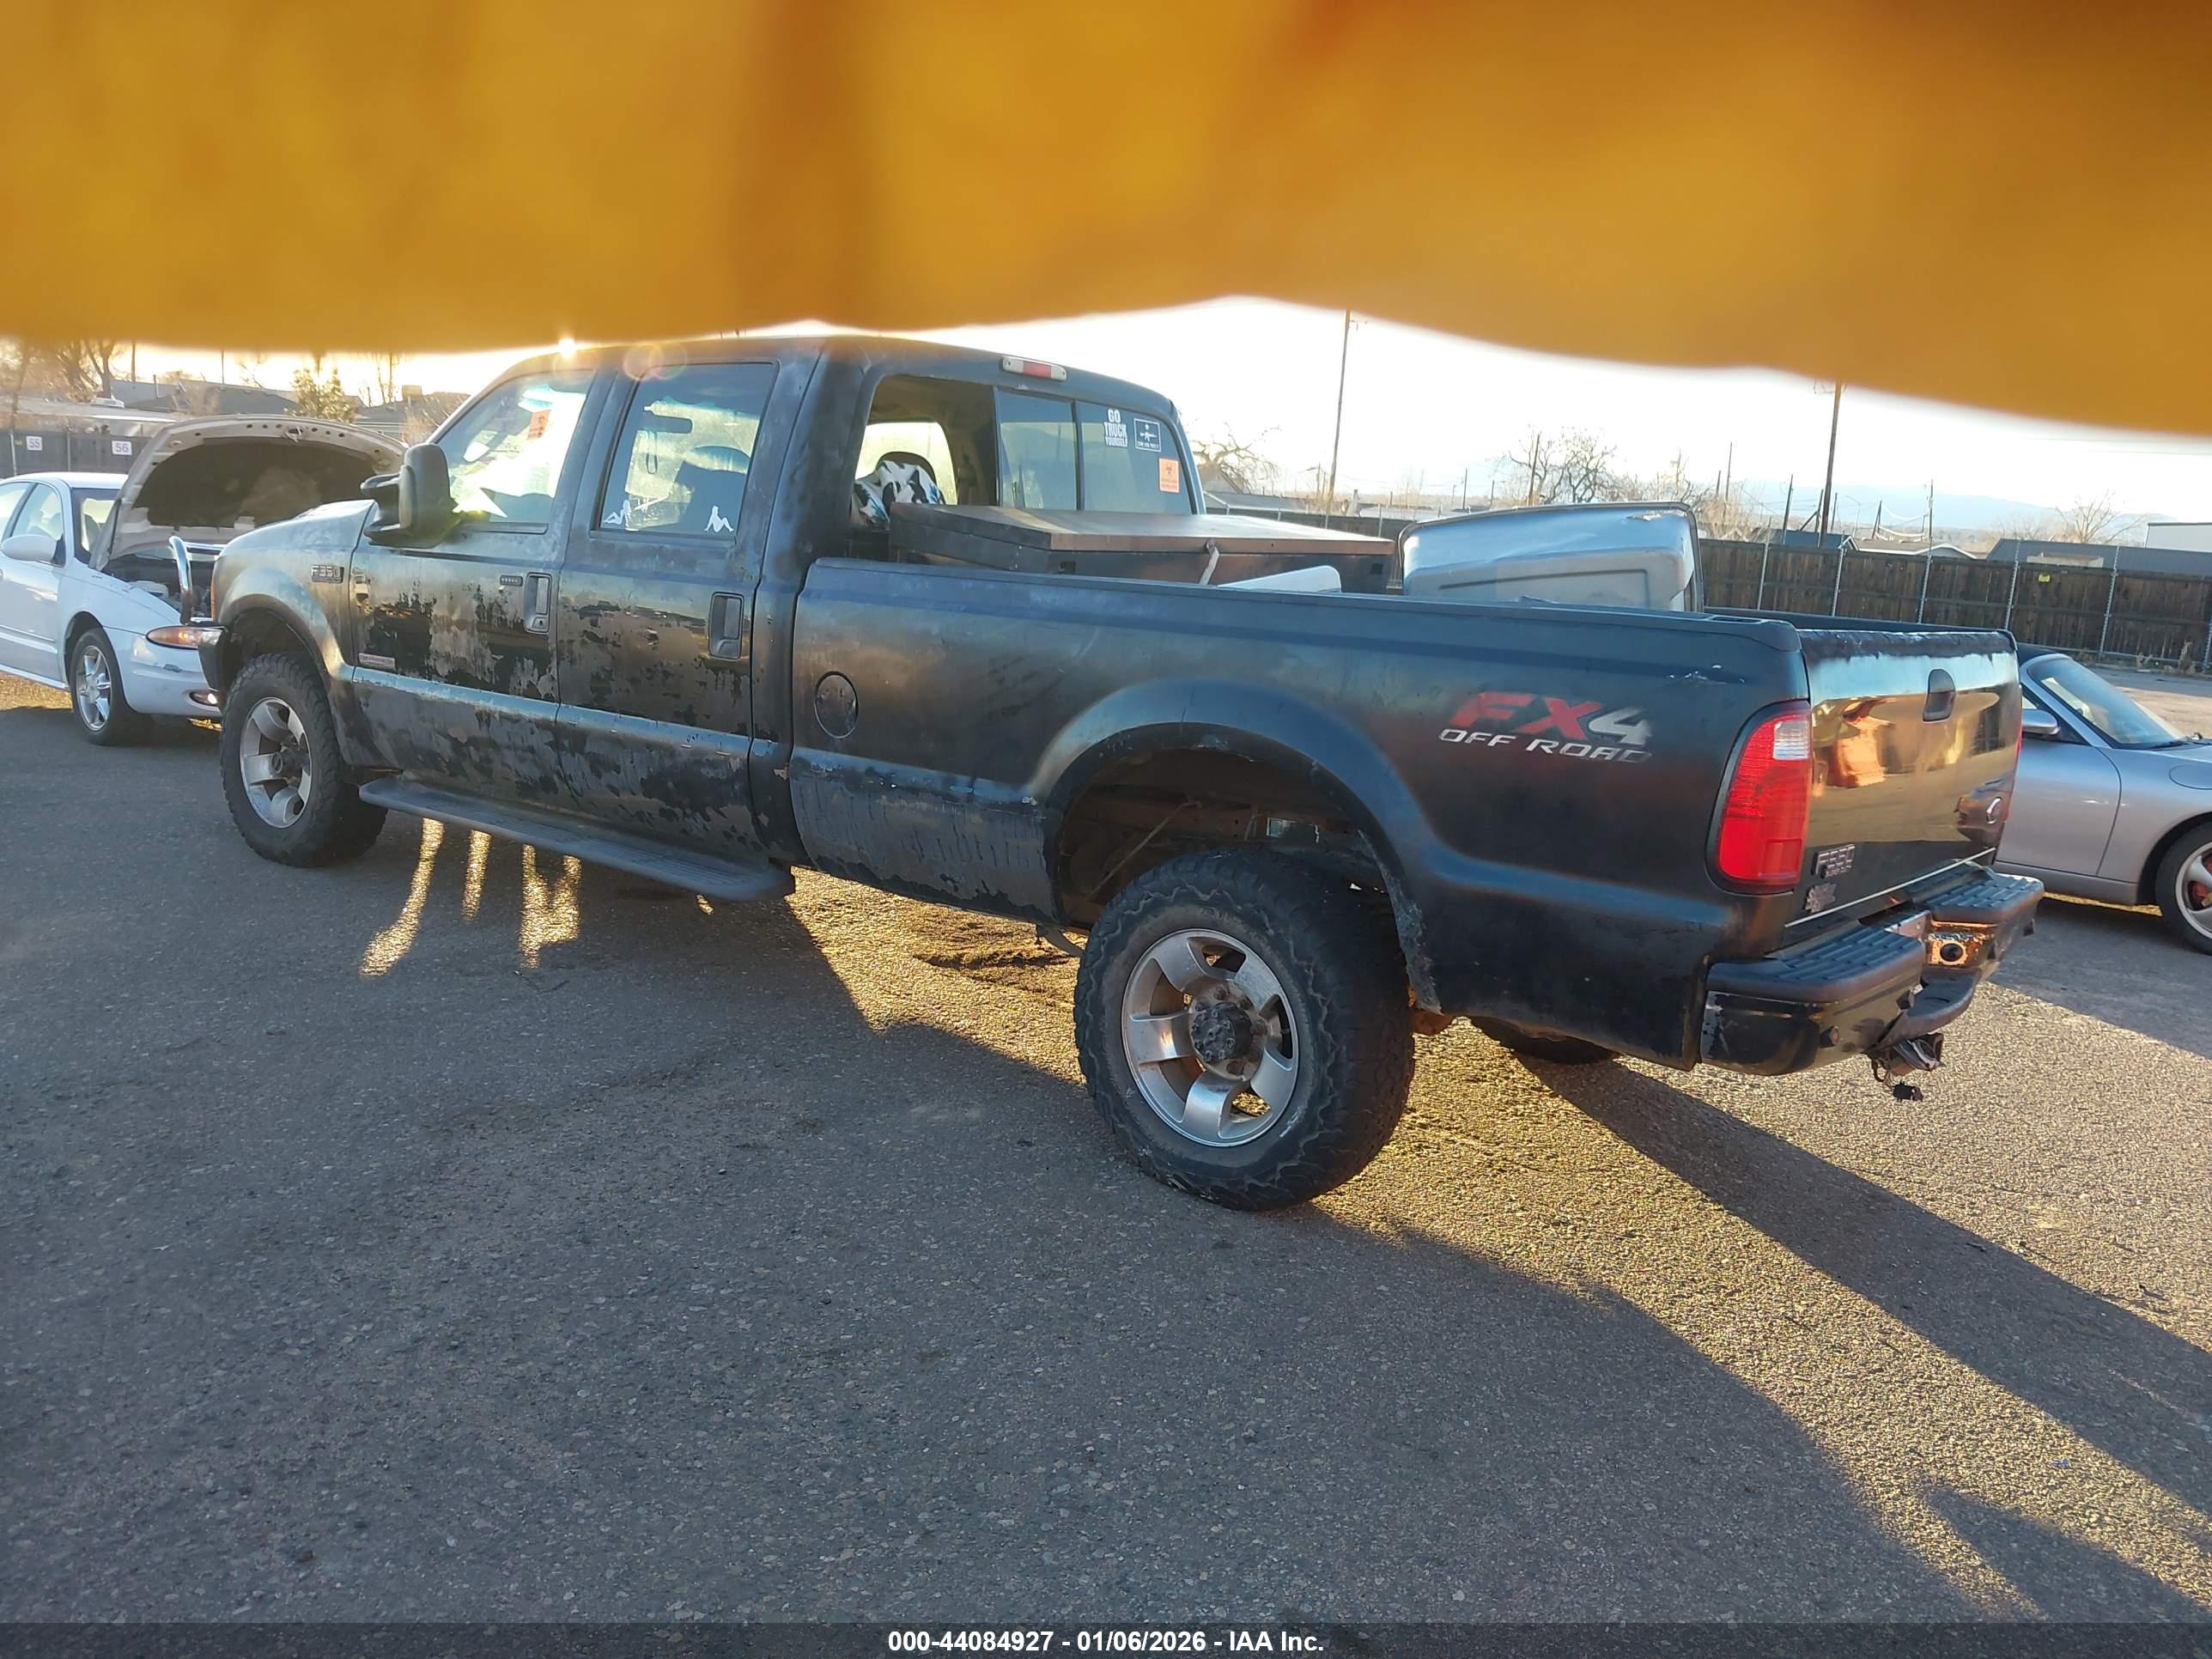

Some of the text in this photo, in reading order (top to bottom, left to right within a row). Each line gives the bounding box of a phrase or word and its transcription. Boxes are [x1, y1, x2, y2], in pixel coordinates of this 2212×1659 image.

[1108, 409, 1121, 423] GO
[1103, 422, 1127, 438] TRUCK
[28, 438, 40, 449] 55
[114, 442, 129, 453] 56
[1449, 690, 1652, 745] FX4
[1438, 728, 1653, 763] OFF ROAD
